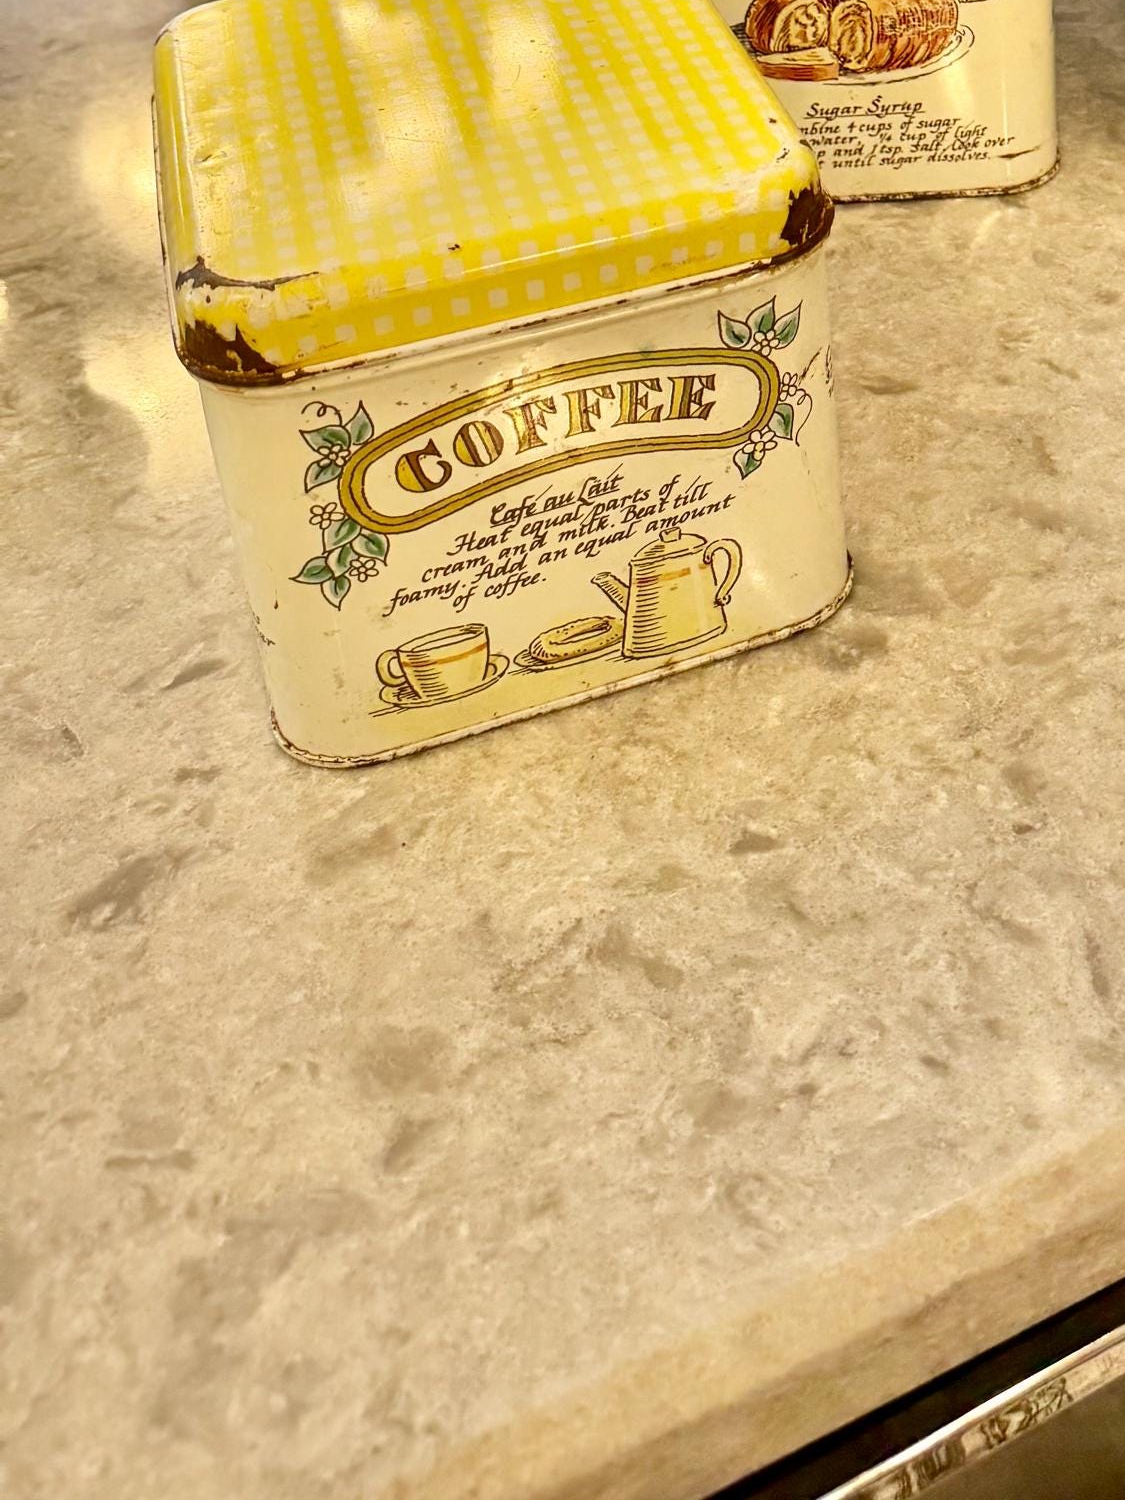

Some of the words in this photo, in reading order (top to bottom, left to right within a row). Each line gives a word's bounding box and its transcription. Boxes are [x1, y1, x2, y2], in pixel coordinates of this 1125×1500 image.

[806, 102, 862, 120] Sugar
[867, 99, 923, 118] Syrup
[847, 121, 856, 133] 4
[859, 123, 892, 137] cups
[916, 118, 962, 133] sugar
[900, 132, 926, 145] cup
[954, 123, 988, 141] light
[833, 144, 864, 157] and
[984, 137, 1015, 148] over
[833, 155, 876, 168] until
[880, 156, 922, 169] sugar
[395, 373, 716, 493] COFFEE
[543, 491, 575, 511] au
[447, 525, 513, 556] Heat
[521, 504, 586, 538] equal
[592, 489, 651, 518] parts
[658, 474, 682, 501] of
[421, 555, 490, 583] cream
[498, 530, 549, 560] and
[558, 513, 615, 543] milk.
[620, 500, 670, 524] Beat
[672, 480, 713, 507] till
[382, 580, 466, 617] foamy.
[471, 553, 528, 584] Add
[538, 548, 567, 565] an
[574, 519, 642, 558] equal
[645, 494, 736, 533] amount
[452, 585, 478, 614] of
[485, 572, 547, 599] coffee.
